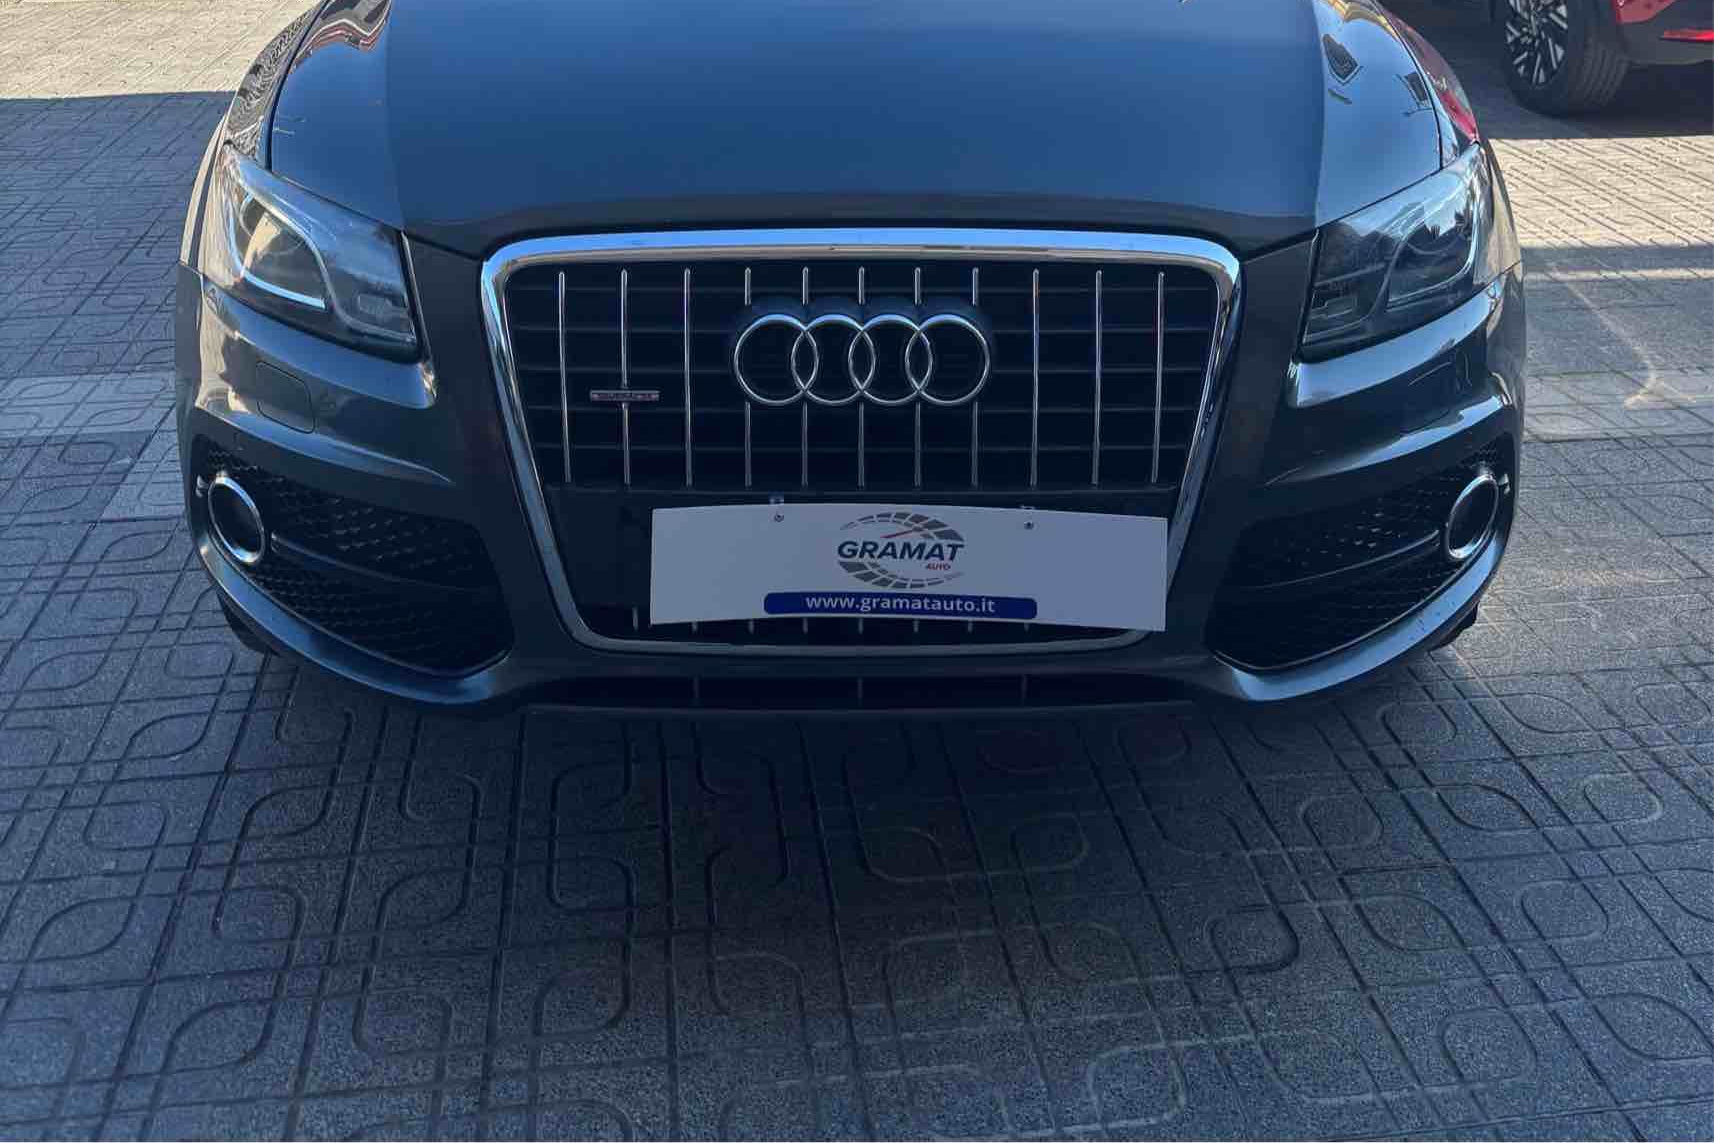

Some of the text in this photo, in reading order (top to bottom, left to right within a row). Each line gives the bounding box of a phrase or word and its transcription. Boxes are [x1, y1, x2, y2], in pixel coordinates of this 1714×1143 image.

[837, 540, 965, 561] GRAMAT
[926, 562, 951, 570] AUTO
[805, 594, 996, 613] www.gramatauto.it
